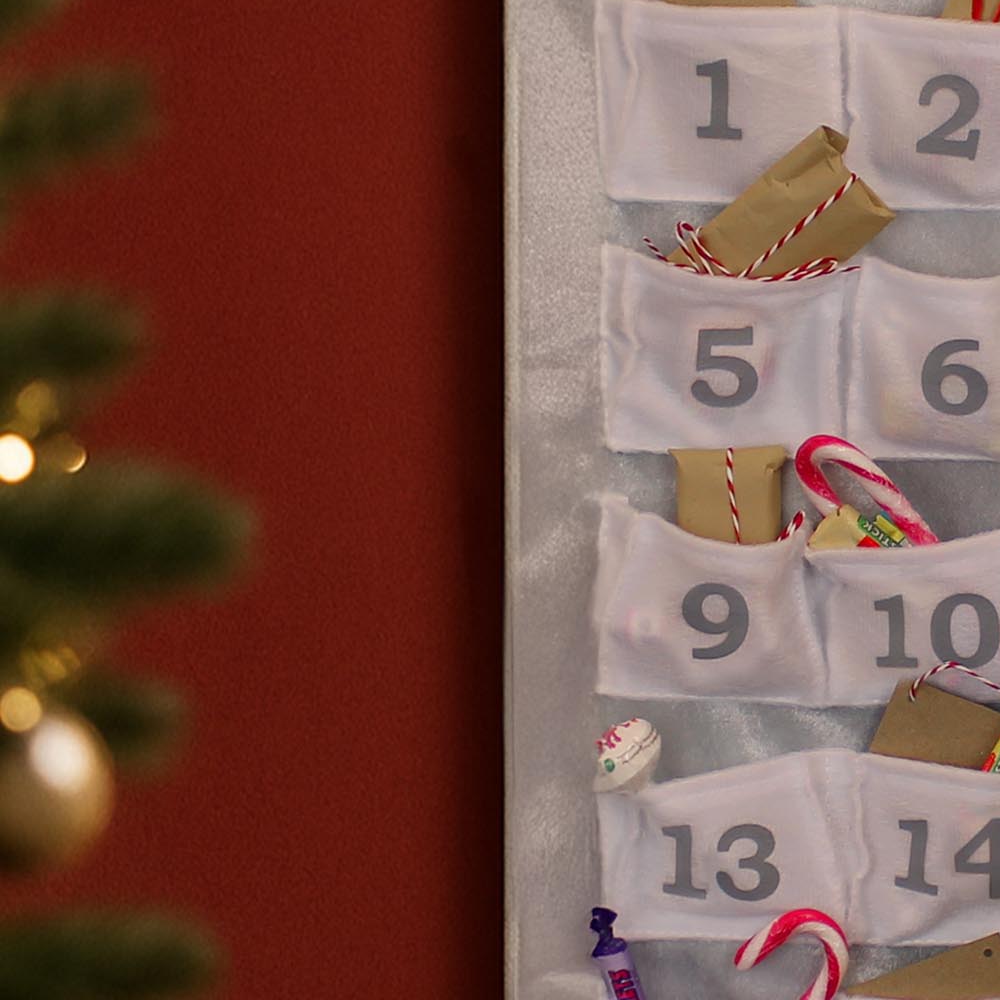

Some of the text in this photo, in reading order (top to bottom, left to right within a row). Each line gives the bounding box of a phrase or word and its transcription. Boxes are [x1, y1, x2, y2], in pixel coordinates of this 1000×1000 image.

[695, 58, 743, 141] 1
[915, 73, 981, 161] 2
[690, 325, 759, 409] 5
[920, 338, 989, 417] 6
[863, 520, 895, 547] TICK
[680, 581, 750, 661] 9
[660, 823, 781, 902] 13
